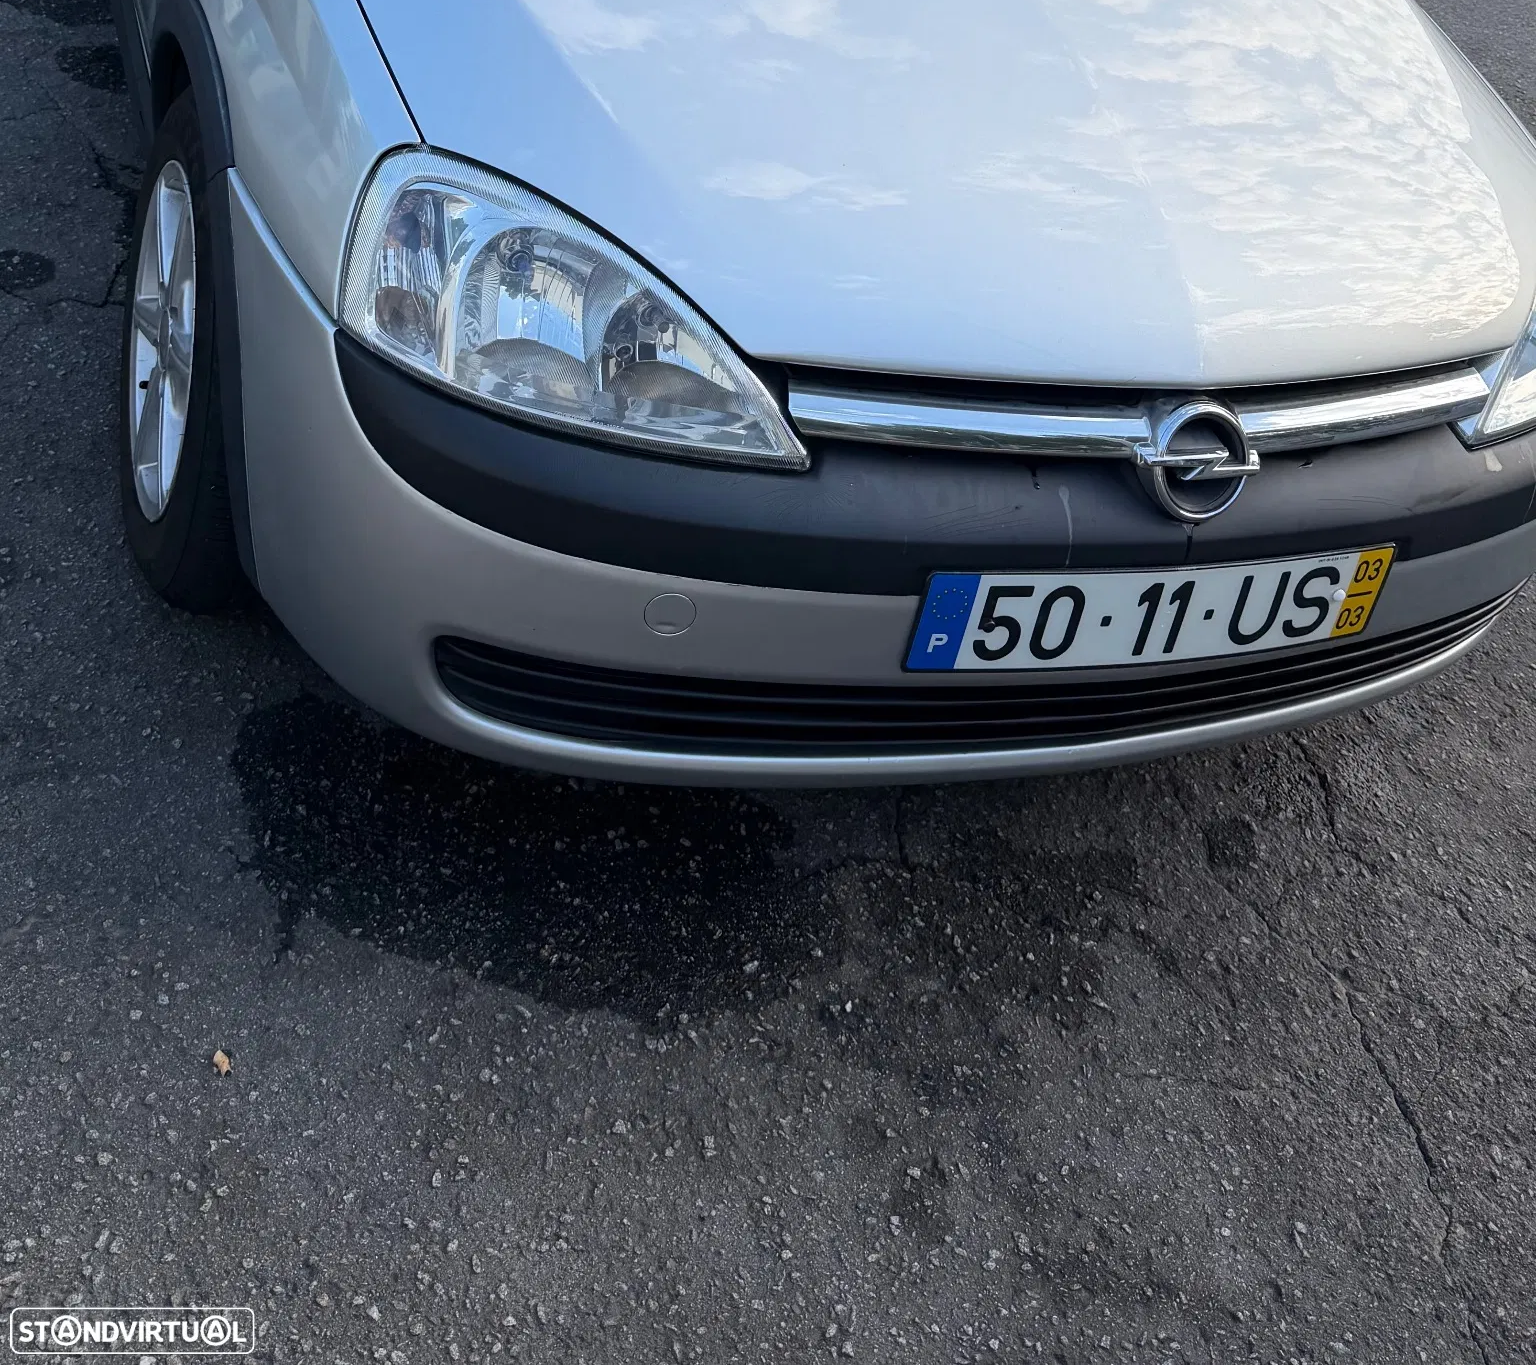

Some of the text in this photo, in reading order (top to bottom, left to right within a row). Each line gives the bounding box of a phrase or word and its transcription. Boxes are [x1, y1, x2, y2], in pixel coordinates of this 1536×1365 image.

[1354, 558, 1383, 583] 03
[1336, 605, 1364, 629] 03
[926, 633, 948, 653] P
